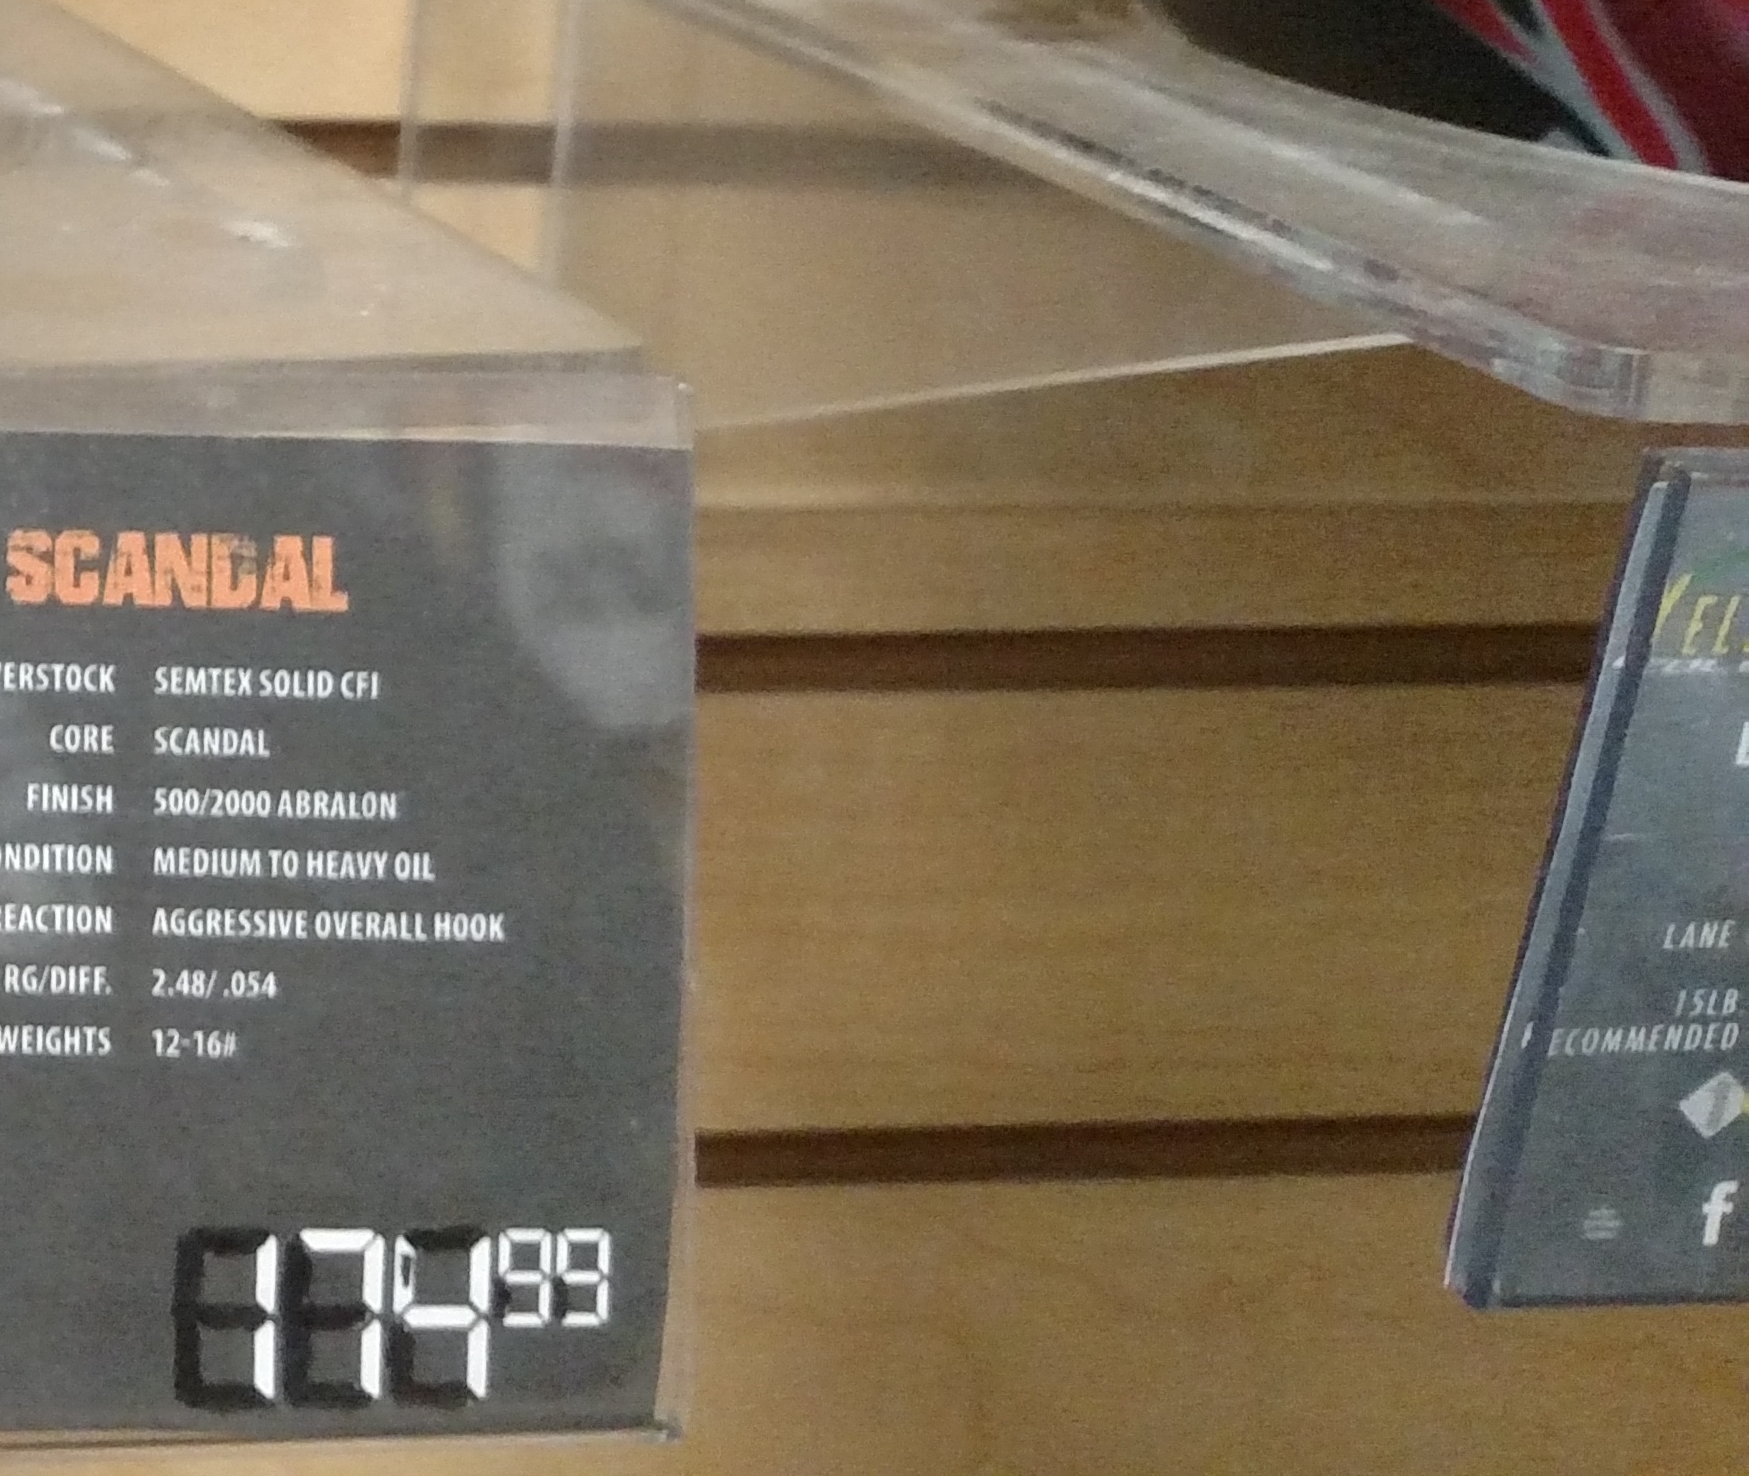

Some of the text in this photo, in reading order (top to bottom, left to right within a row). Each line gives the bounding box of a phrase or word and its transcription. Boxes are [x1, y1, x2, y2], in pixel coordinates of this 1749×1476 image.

[5, 528, 349, 613] SCANDAL
[153, 666, 380, 700] SEMTEX SOLID CFI
[49, 723, 115, 754] CORE
[153, 726, 271, 758] SCANDAL
[26, 782, 114, 814] FINISH
[153, 786, 398, 820] 500/2000 ABRALON
[153, 846, 436, 882] MEDIUM TO HEAVY OIL
[151, 907, 506, 943] AGGRESSIVE OVERALL HOOK
[1662, 918, 1737, 950] LANE
[3, 963, 113, 996] RG/DIFF.
[1675, 987, 1740, 1018] 15LB
[152, 1027, 237, 1059] 12-16#
